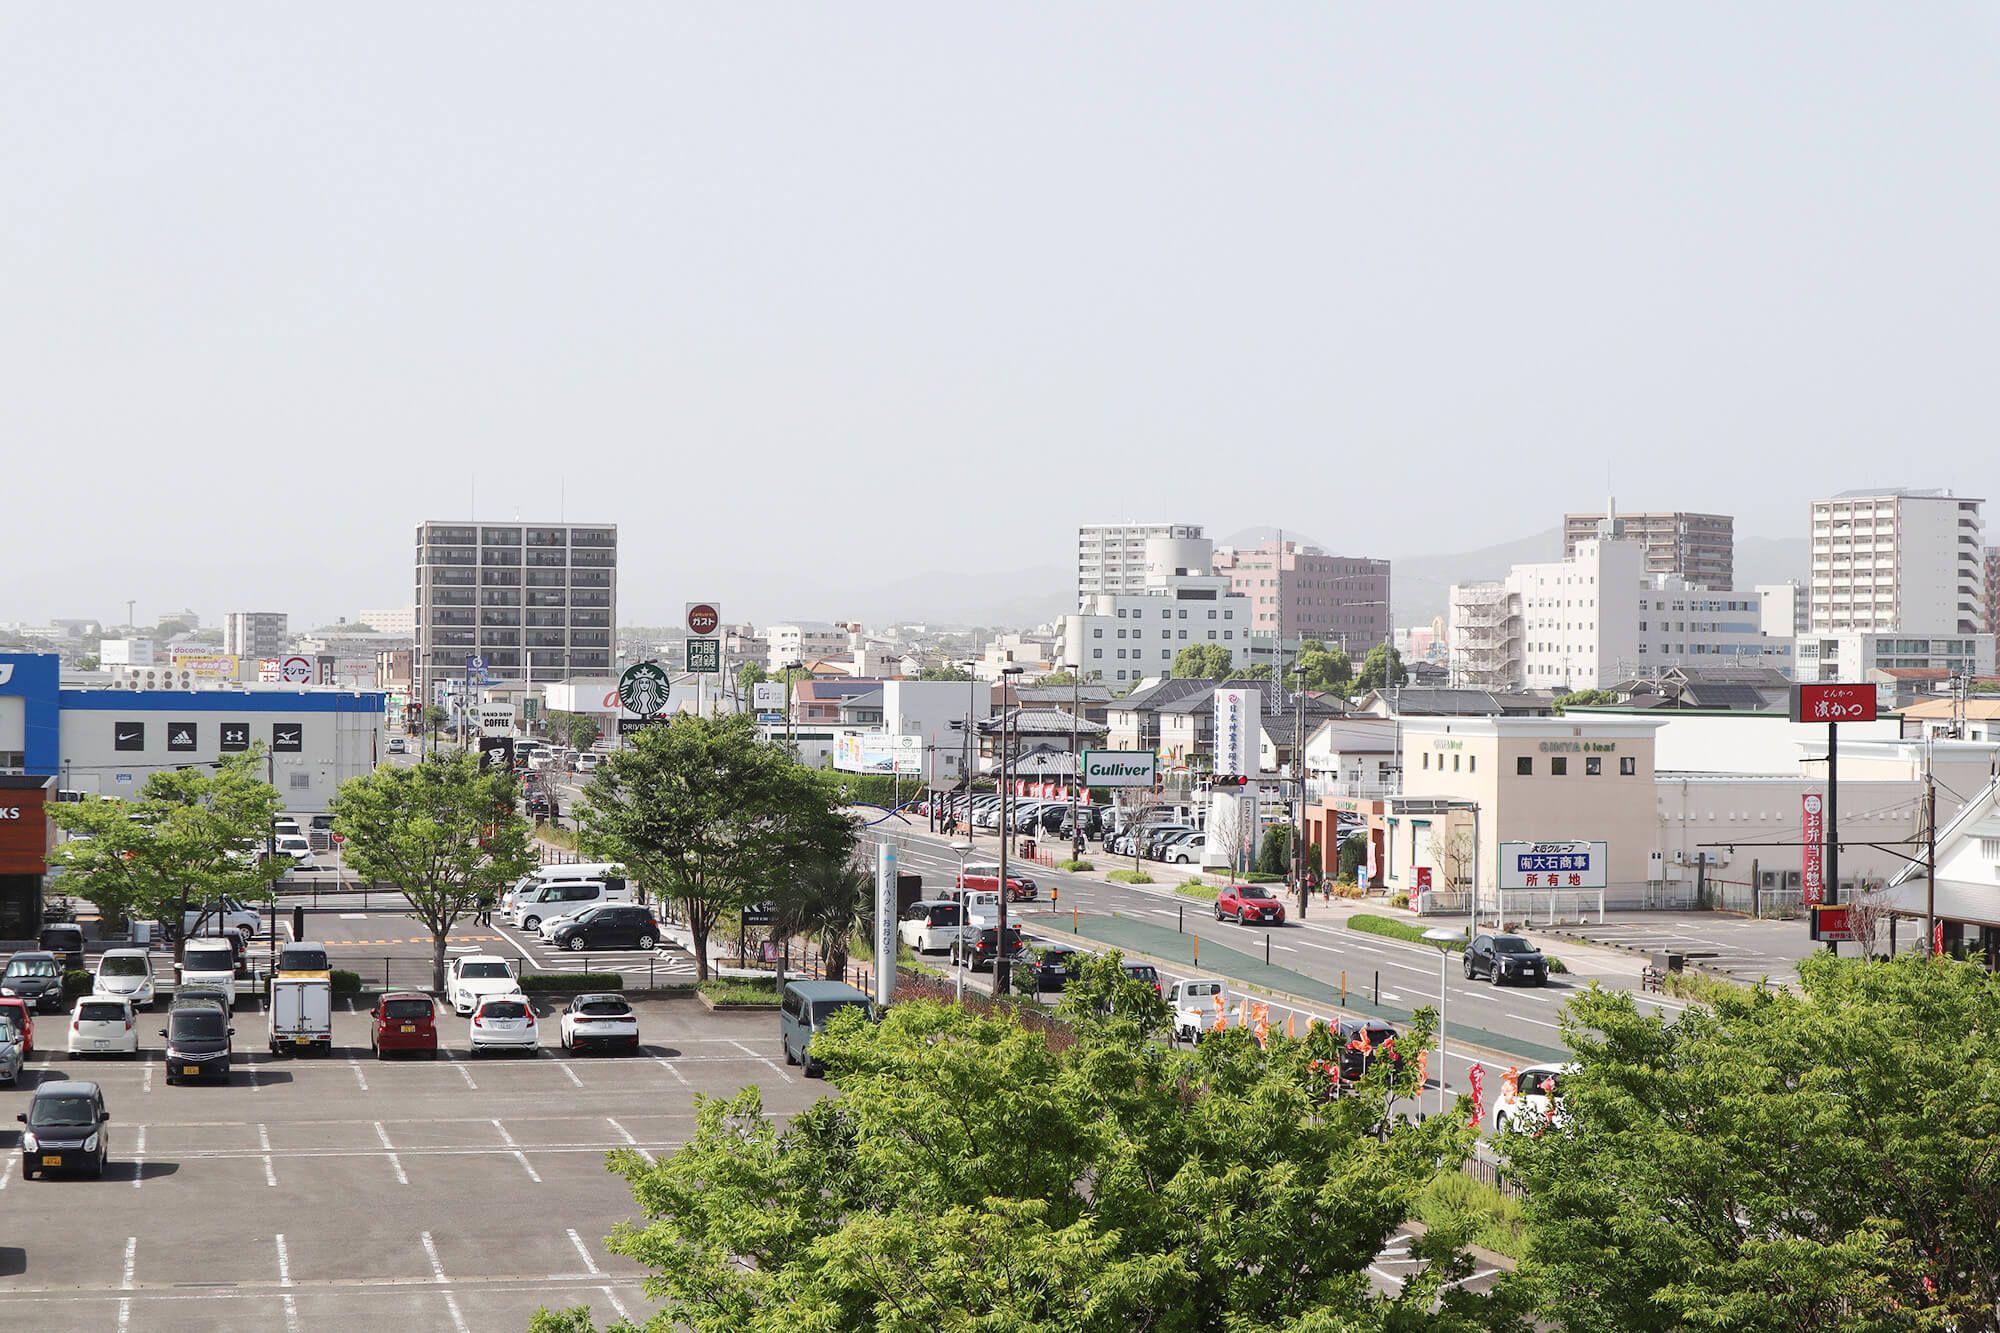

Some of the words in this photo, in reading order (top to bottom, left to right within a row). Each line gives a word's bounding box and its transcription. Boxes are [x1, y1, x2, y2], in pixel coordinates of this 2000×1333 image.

[692, 617, 715, 626] ガスト
[282, 667, 312, 675] スシロー
[1823, 689, 1854, 698] とんかつ
[1814, 700, 1863, 718] 濱かつ
[484, 719, 509, 728] COFFEE
[1539, 742, 1580, 752] GINYA
[1593, 742, 1615, 752] leaf
[1089, 763, 1150, 776] Gulliver
[1531, 844, 1576, 853] 大石グループ
[883, 870, 891, 915] シーハット
